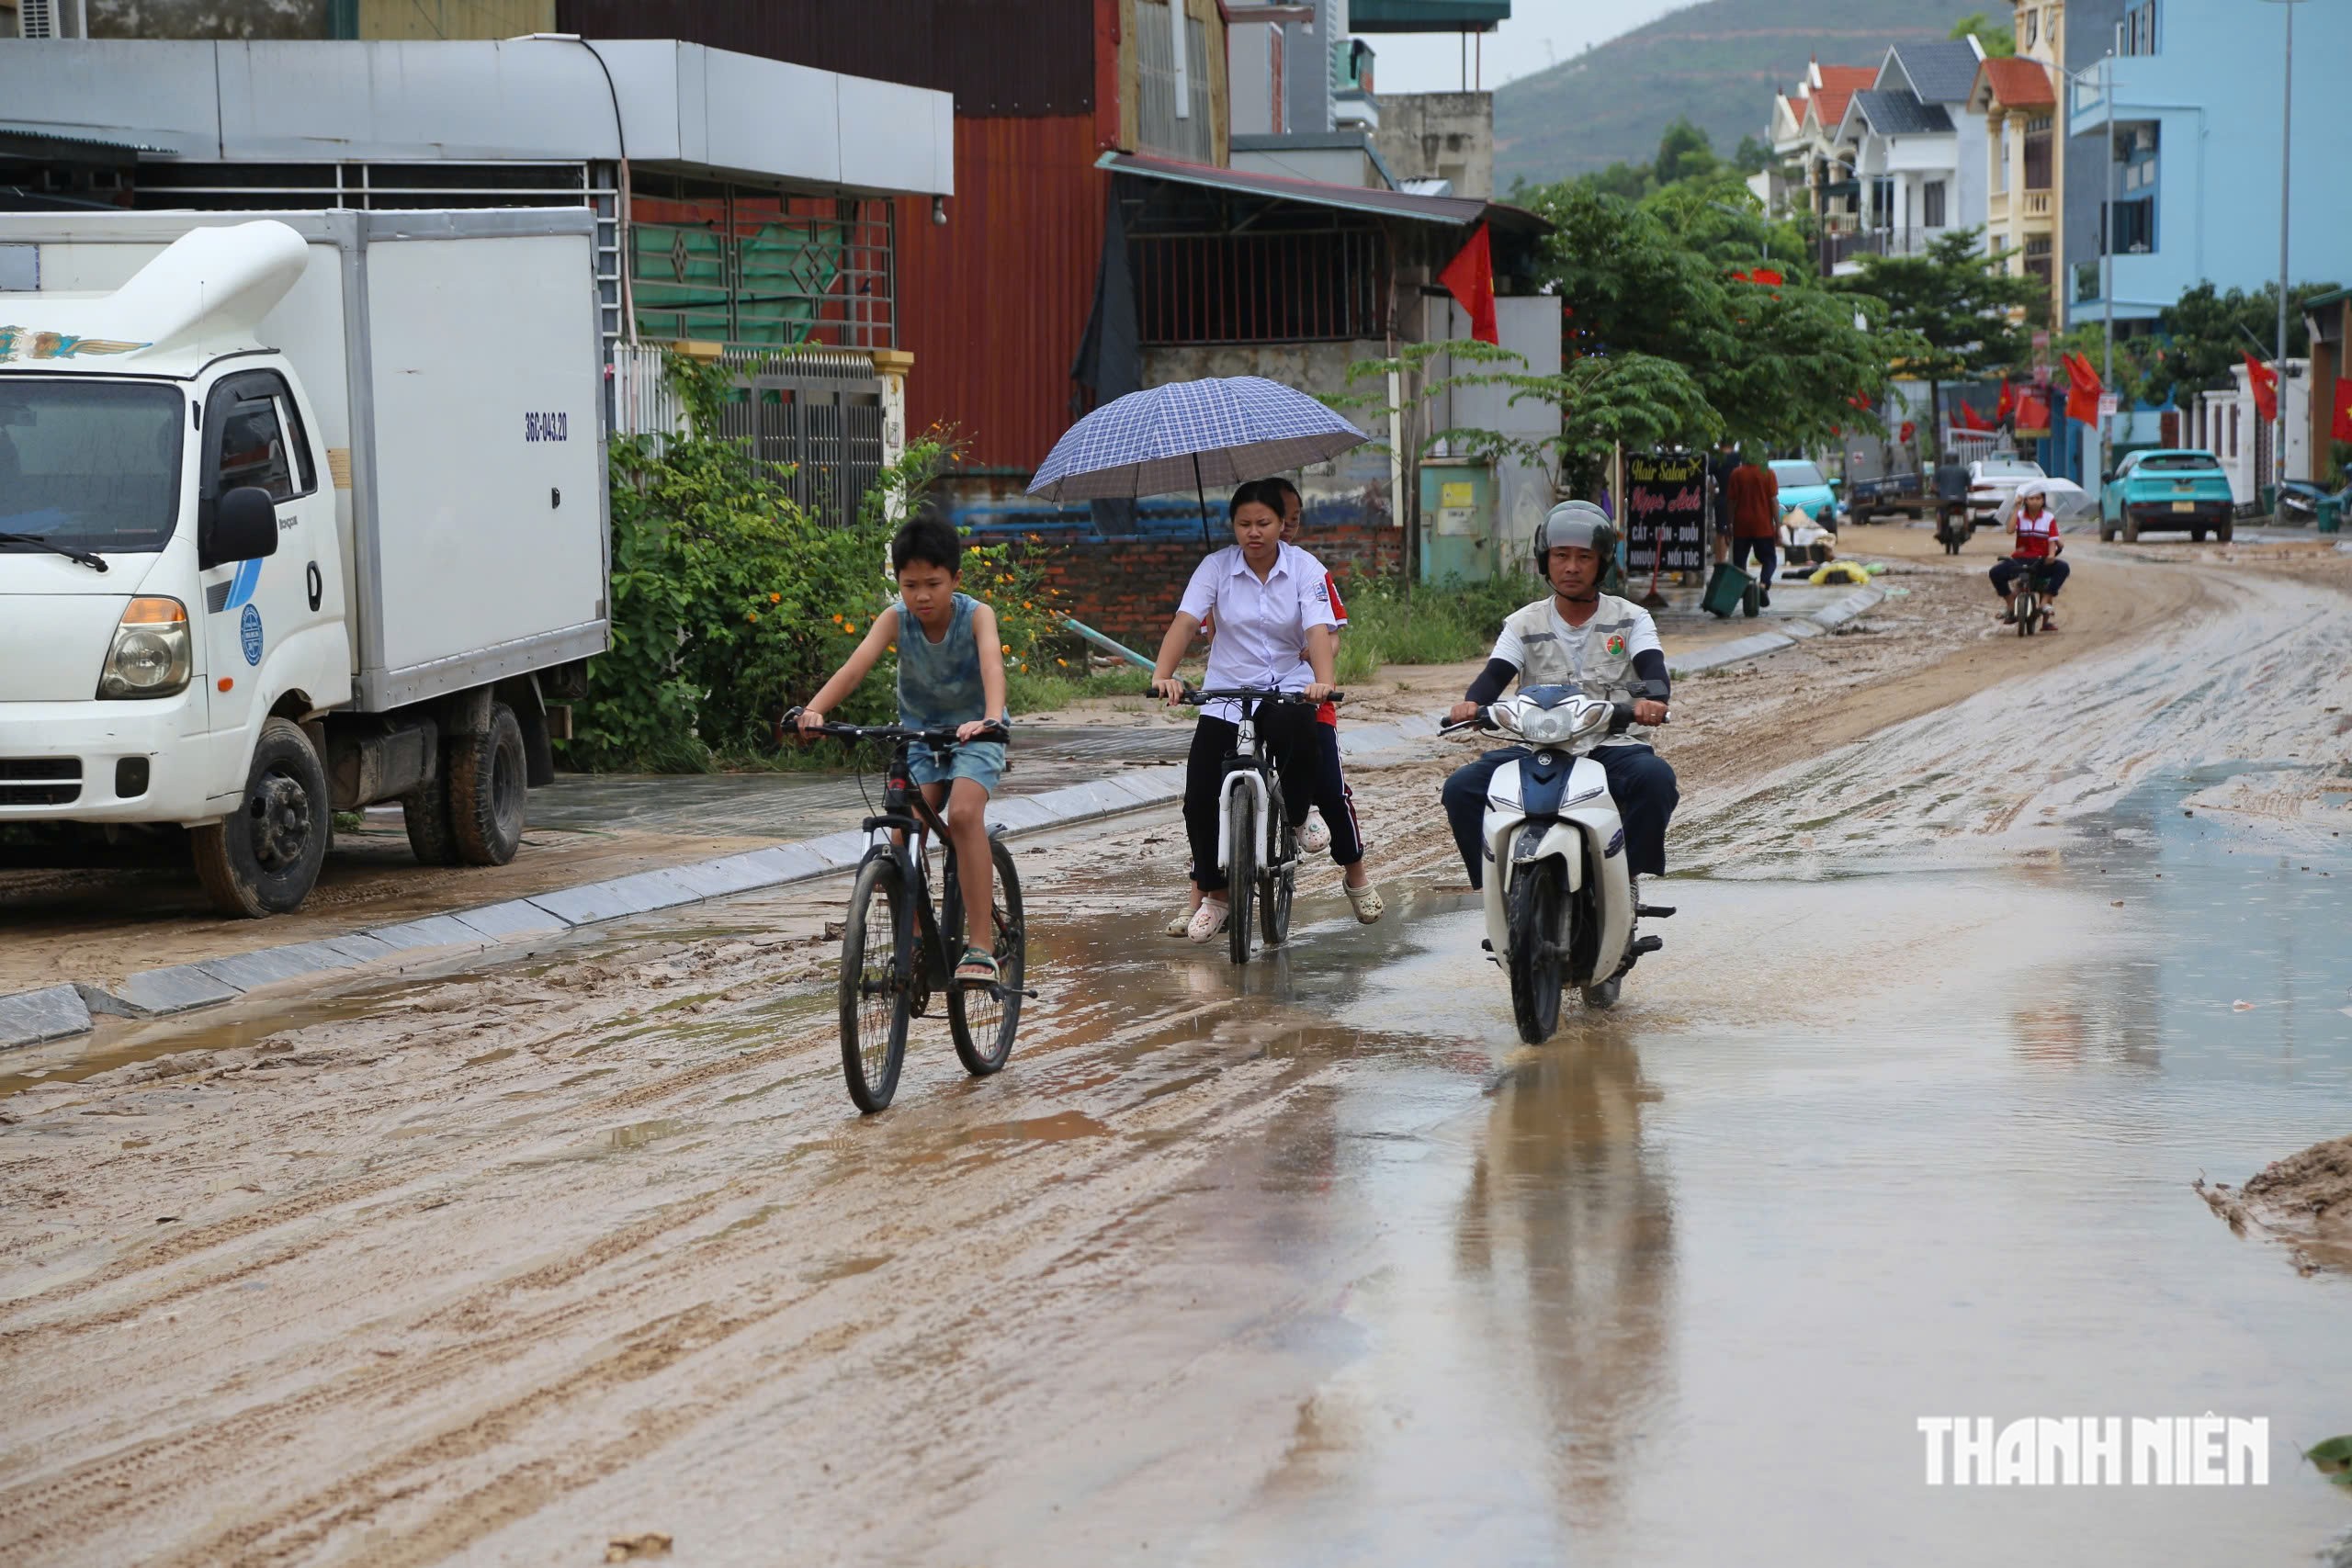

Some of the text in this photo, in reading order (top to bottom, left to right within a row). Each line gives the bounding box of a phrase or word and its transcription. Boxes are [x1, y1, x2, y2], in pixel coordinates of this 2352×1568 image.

[526, 412, 567, 442] 36C-043.20
[1632, 459, 1688, 480] Hair Salon
[1668, 485, 1701, 512] Anh
